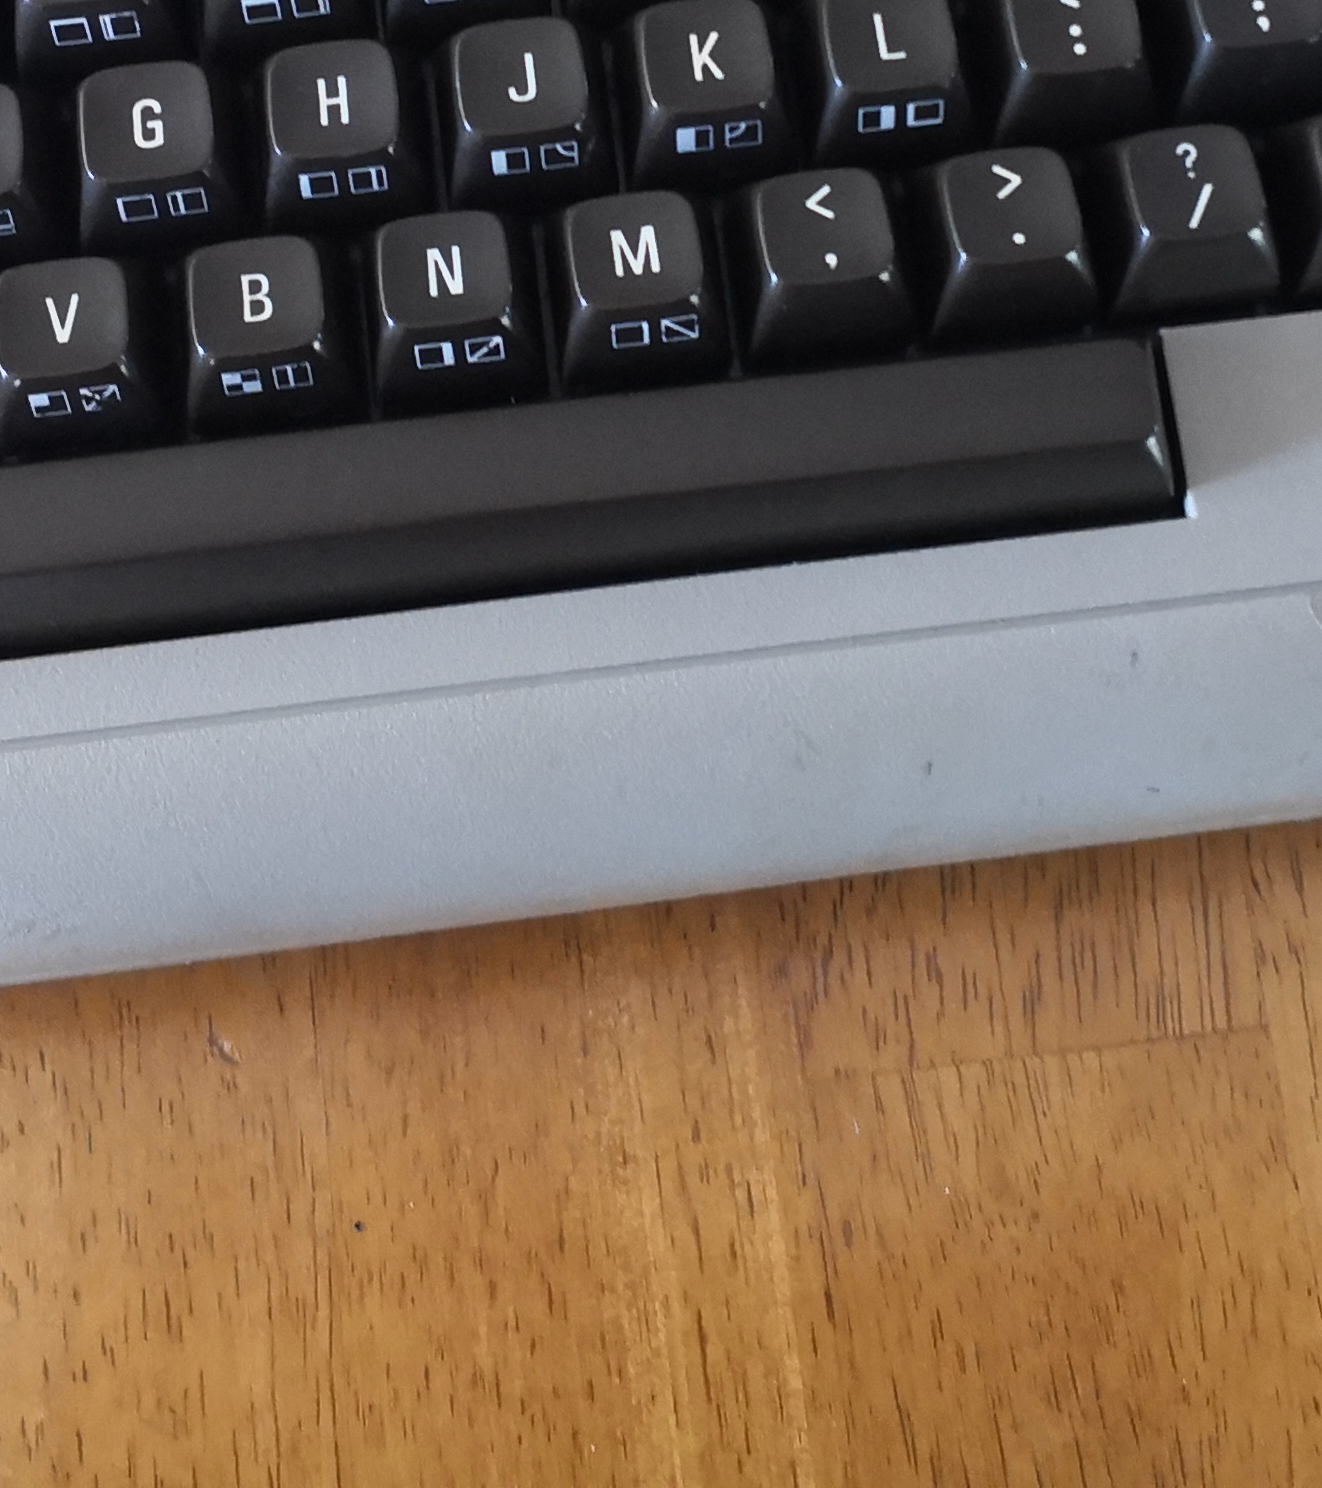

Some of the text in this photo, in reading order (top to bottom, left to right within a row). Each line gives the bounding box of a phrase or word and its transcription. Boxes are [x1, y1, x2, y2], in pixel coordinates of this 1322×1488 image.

[872, 12, 907, 61] L
[1068, 23, 1087, 56] :
[1252, 0, 1271, 32] ;
[507, 52, 537, 103] J
[689, 30, 725, 82] K
[132, 98, 165, 149] G
[316, 75, 350, 127] H
[991, 164, 1022, 200] >
[1175, 142, 1198, 179] ?
[805, 183, 835, 220] <
[1188, 183, 1214, 229] /
[426, 245, 464, 298] N
[609, 224, 661, 278] M
[45, 293, 79, 344] V
[240, 273, 273, 323] B
